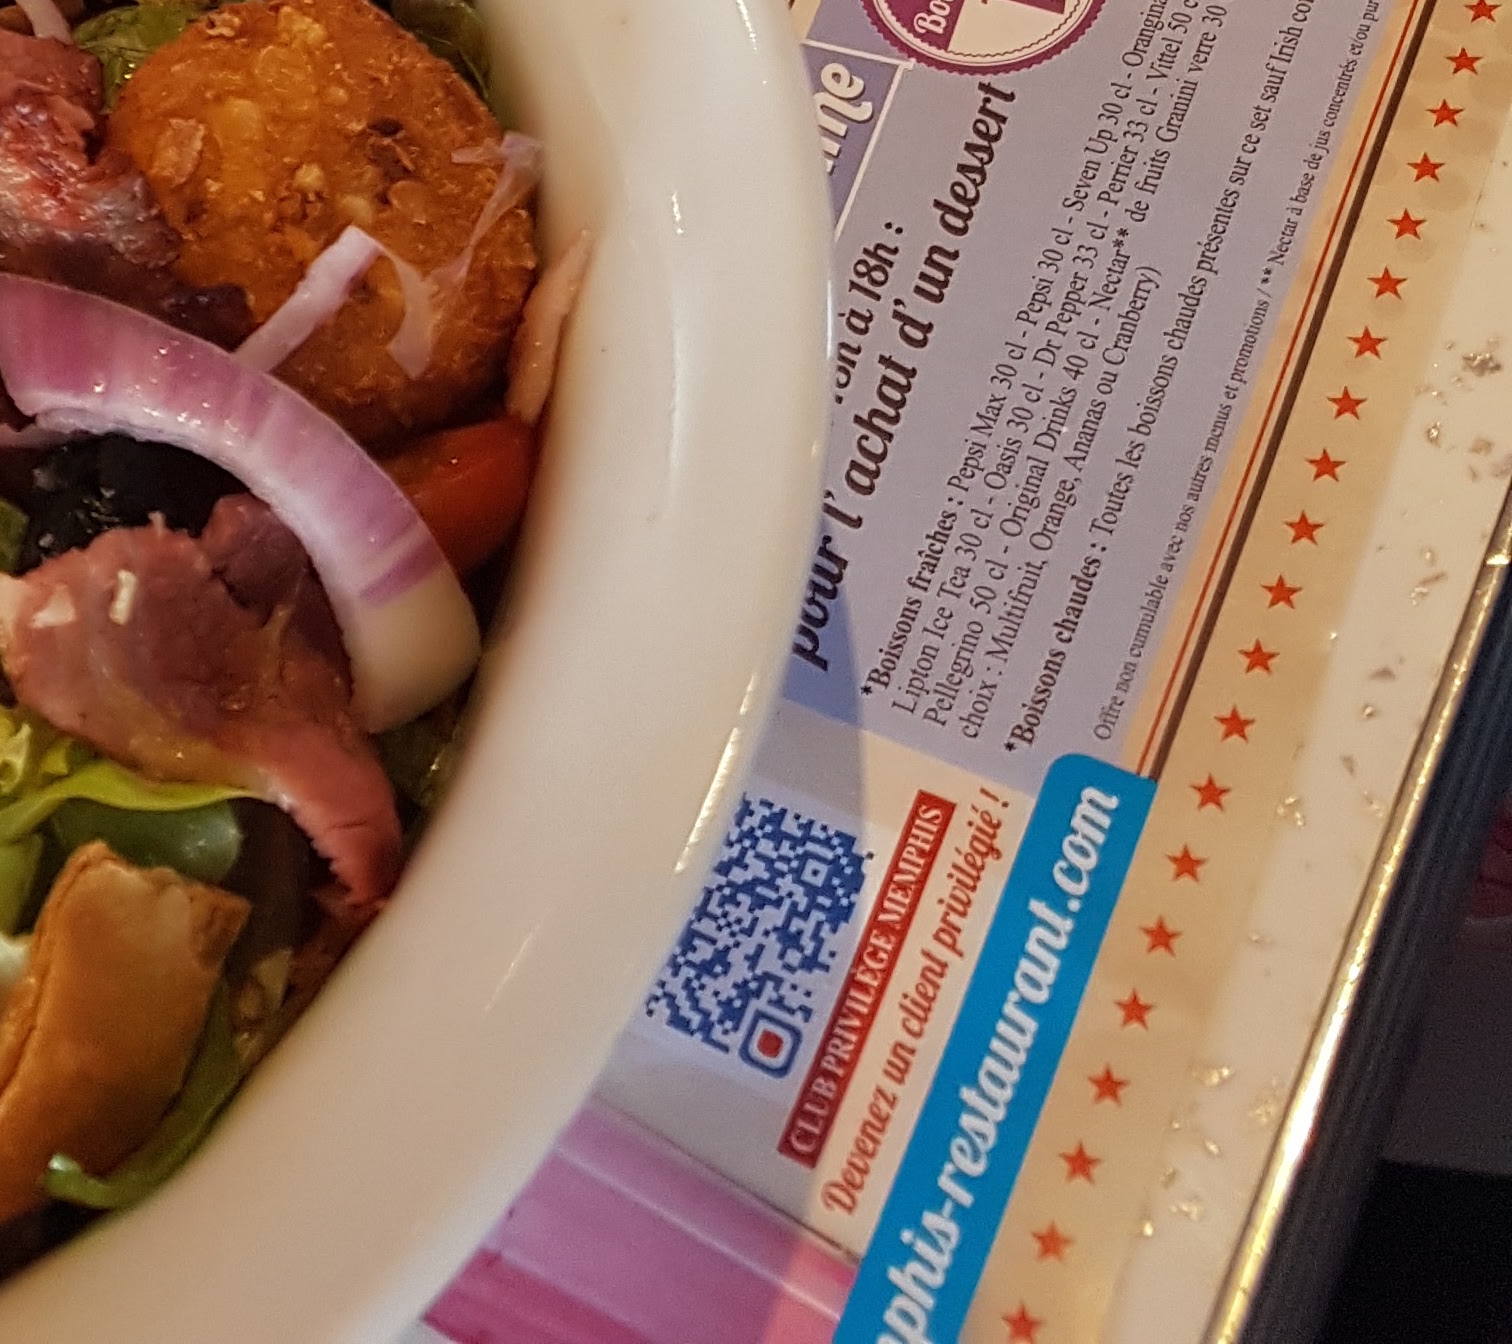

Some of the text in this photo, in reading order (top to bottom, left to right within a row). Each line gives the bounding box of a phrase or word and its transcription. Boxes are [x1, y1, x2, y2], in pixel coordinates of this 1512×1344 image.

[1253, 59, 1289, 104] sauf
[1268, 19, 1305, 65] Irish
[882, 234, 962, 353] d'un
[924, 75, 1018, 240] dessert
[1063, 155, 1102, 213] Seven
[845, 235, 899, 302] 18h
[1188, 183, 1248, 276] présentes
[1017, 273, 1060, 329] Pepsi
[1158, 270, 1211, 353] chaudes
[891, 32, 1184, 717] Lipton Oasis Pepper Perrier Vittel
[921, 73, 1200, 730] Pellegrino Original Drinks fruits Granini
[969, 388, 1009, 439] Max
[1126, 348, 1181, 438] boissons
[946, 436, 993, 495] Pepsi
[954, 260, 1168, 741] choix Multifruit, Orange, Ananas Cranberry)
[1087, 465, 1137, 539] Toutes
[904, 505, 961, 594] fraîches
[1047, 551, 1105, 646] chaudes
[789, 801, 946, 1156] CLUB PRIVILÈGE MEMPHIS
[819, 805, 1015, 1218] Devenez client privilégié
